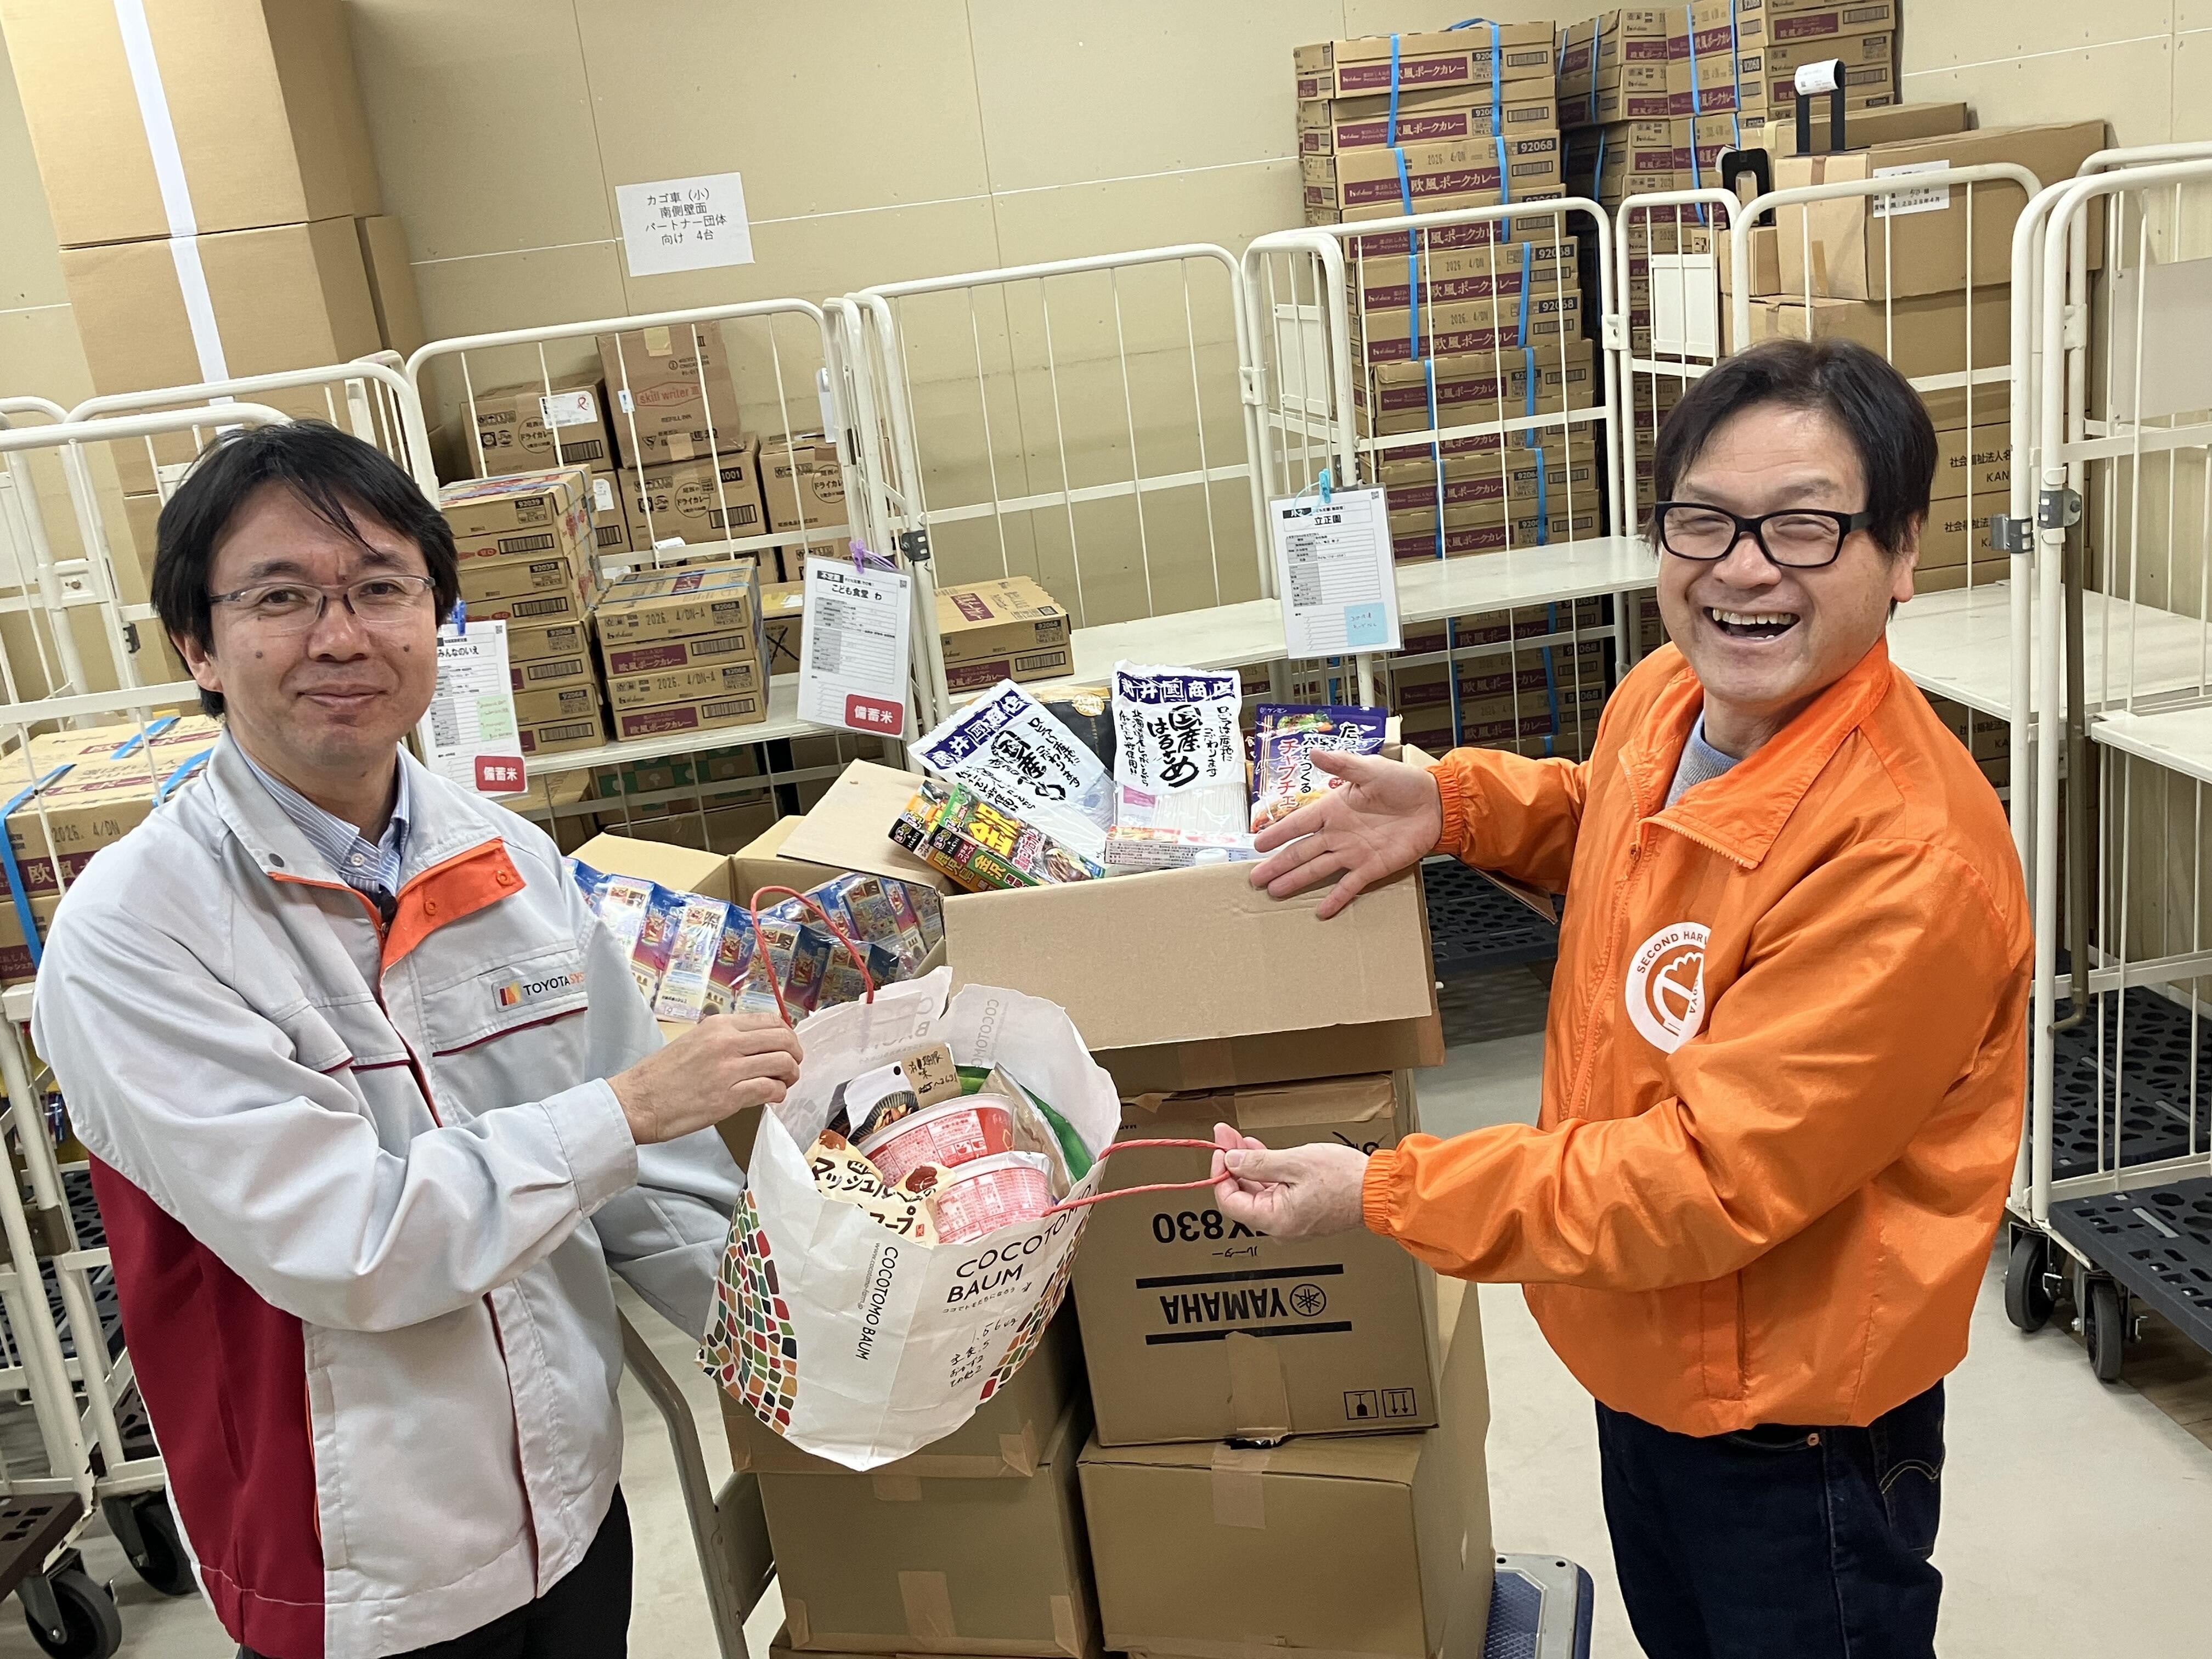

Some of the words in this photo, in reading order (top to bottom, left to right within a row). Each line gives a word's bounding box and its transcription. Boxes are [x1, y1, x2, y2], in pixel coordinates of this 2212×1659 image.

[1476, 51, 1493, 61] 920
[1475, 107, 1493, 117] 920
[1521, 140, 1554, 153] 92068
[1410, 173, 1500, 193] 欧風ポークカレー
[659, 202, 707, 219] 南側壁面
[645, 213, 727, 232] パートナー団体
[661, 233, 684, 246] 向け
[696, 228, 714, 241] 4台
[640, 391, 660, 404] skill
[662, 388, 690, 400] writer
[1950, 450, 2011, 468] 社会福祉法人名
[721, 472, 740, 481] 1001
[1987, 472, 2010, 483] KAN
[518, 499, 541, 509] 92039
[832, 584, 868, 599] こども食堂
[1564, 597, 1596, 607] 9068
[1037, 621, 1058, 630] 92068
[437, 645, 479, 658] みんなのいえ
[1566, 643, 1598, 654] 9068
[657, 678, 680, 690] 2026.
[1463, 675, 1546, 693] 欧風ポーカレー
[1567, 691, 1599, 703] 9068
[854, 705, 893, 724] 備蓄米
[1169, 704, 1204, 753] 国産
[1464, 721, 1550, 740] 欧風ポーカレー
[1147, 716, 1200, 789] はるさめ
[1203, 727, 1218, 777] こだわります
[483, 766, 518, 781] 備蓄米
[1277, 738, 1301, 809] チャプチェ
[968, 802, 1020, 859] 金沢
[27, 860, 88, 884] 欧風
[974, 855, 1007, 881] 金沢
[1637, 933, 1679, 974] SECOND
[523, 976, 571, 996] TOYOTA
[956, 1183, 1091, 1279] COCOTOMO
[1153, 1209, 1270, 1244] X830
[1212, 1245, 1258, 1258] ルーター
[866, 1246, 899, 1325] COCOTOMO
[946, 1263, 1024, 1304] BAUM
[1160, 1287, 1289, 1325] YAMAHA
[855, 1326, 876, 1361] BAUM
